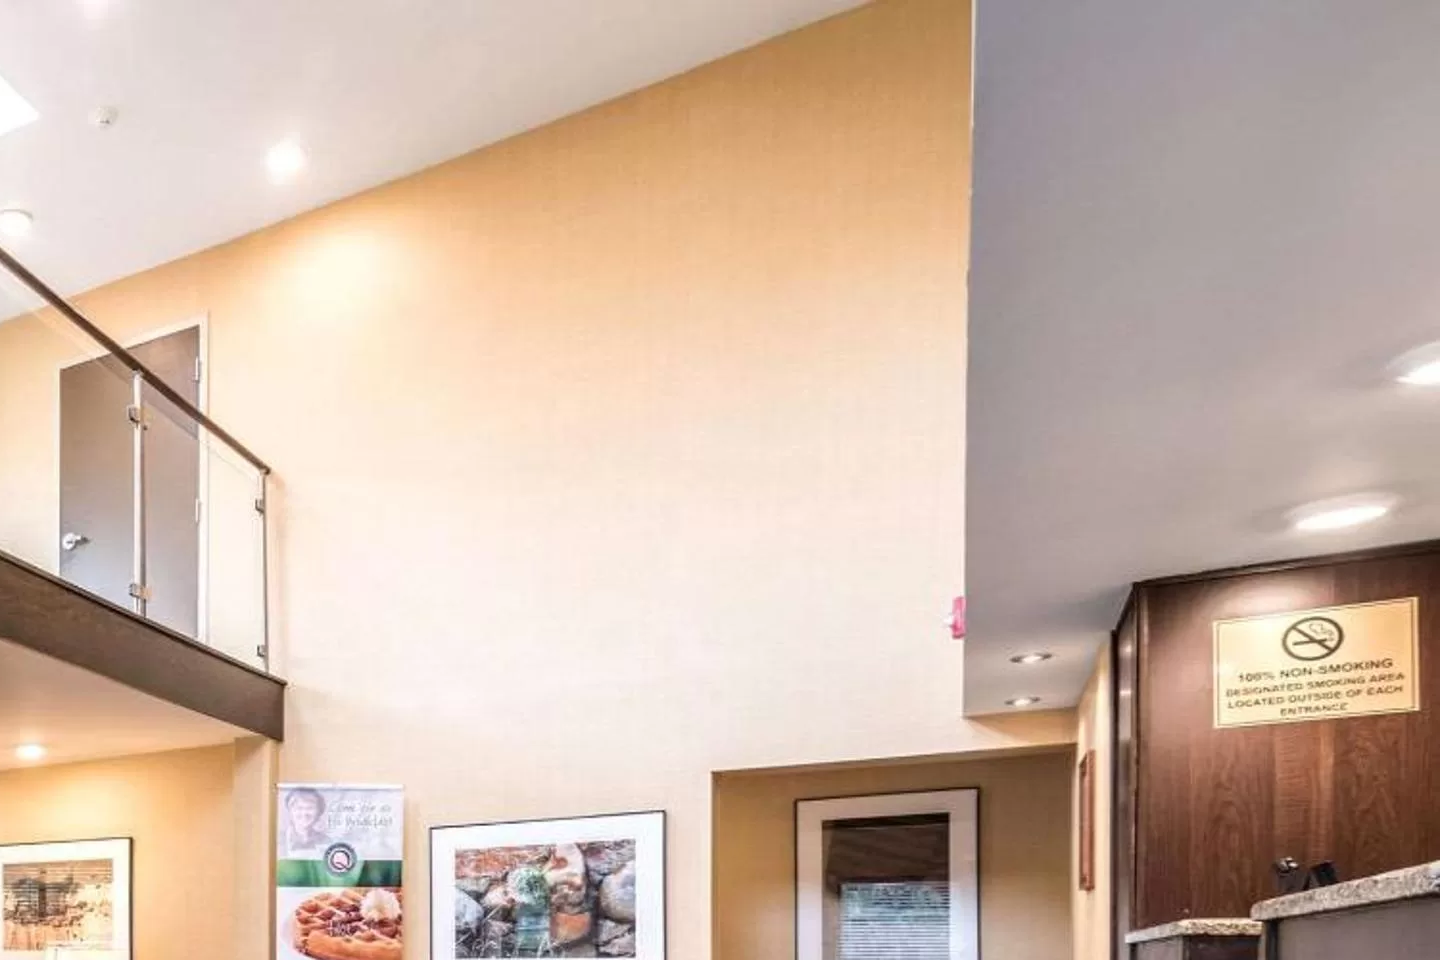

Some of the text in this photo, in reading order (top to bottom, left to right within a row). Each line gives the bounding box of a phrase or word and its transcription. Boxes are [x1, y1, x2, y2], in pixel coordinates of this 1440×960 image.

[1239, 658, 1393, 683] 100% NON-SMOKING
[1226, 672, 1405, 697] DESIGNATED SMOKING AREA
[1227, 685, 1403, 709] LOCATED OUTSIDE OF EACH
[1280, 702, 1348, 717] ENTRANCE
